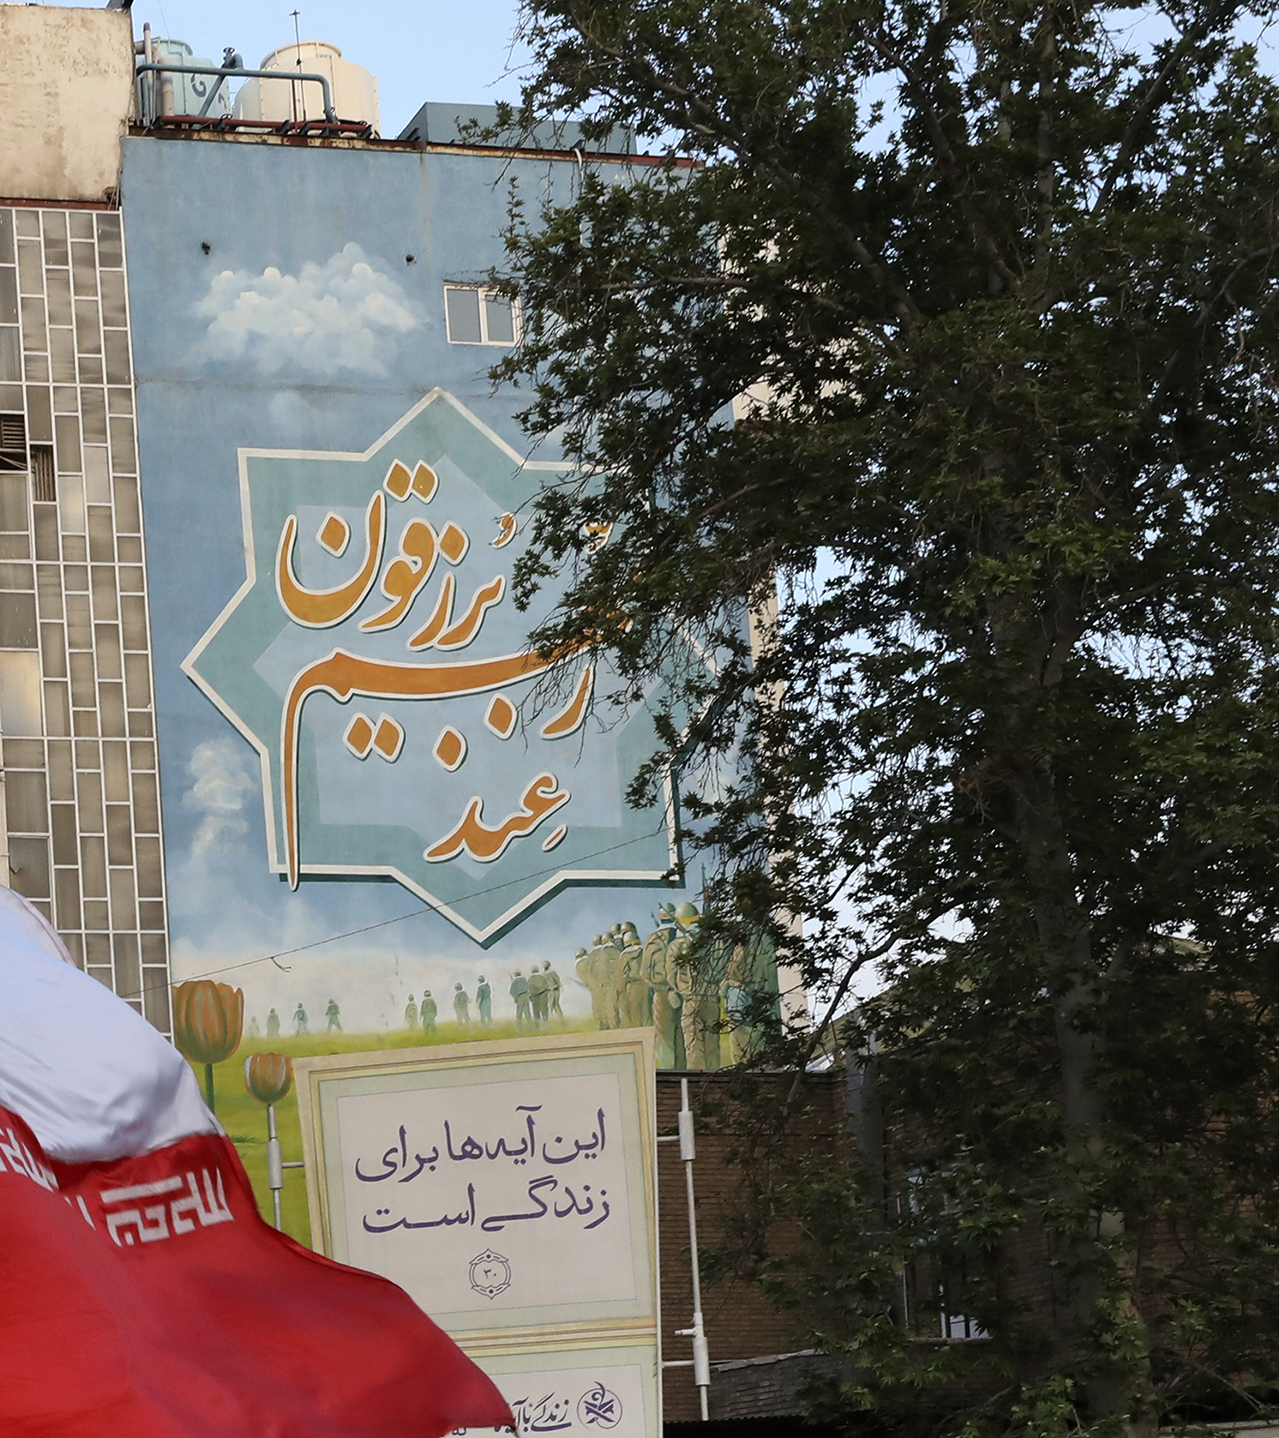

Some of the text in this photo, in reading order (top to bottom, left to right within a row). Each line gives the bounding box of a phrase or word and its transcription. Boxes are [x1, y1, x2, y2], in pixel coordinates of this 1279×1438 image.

[355, 1124, 440, 1184] برای
[542, 1107, 606, 1165] این
[362, 1175, 611, 1234] زندگی است
[483, 1269, 498, 1280] ۳۰
[531, 1391, 572, 1432] زندگی
